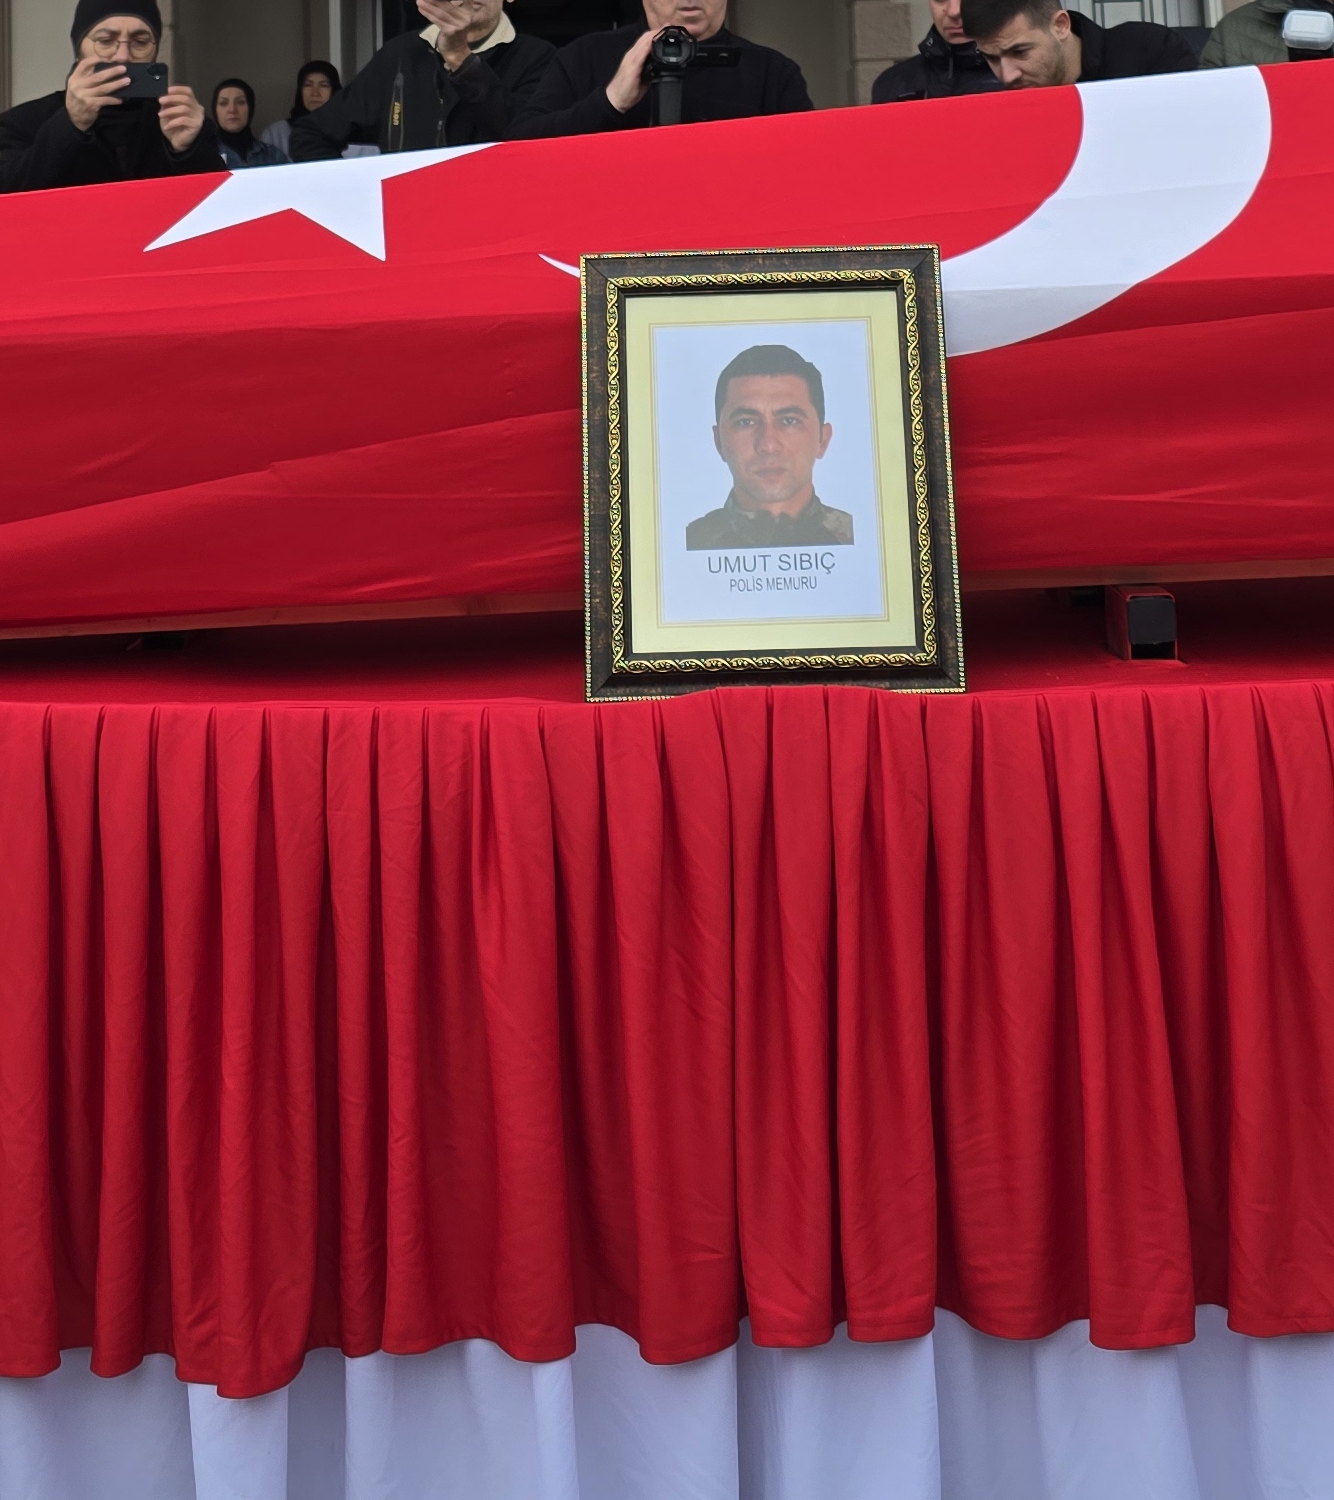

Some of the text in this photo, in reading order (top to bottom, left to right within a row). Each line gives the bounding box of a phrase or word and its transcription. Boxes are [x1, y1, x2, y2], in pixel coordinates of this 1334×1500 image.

[707, 552, 836, 575] UMUT SIBIÇ
[729, 576, 818, 593] POLİS MEMURU
